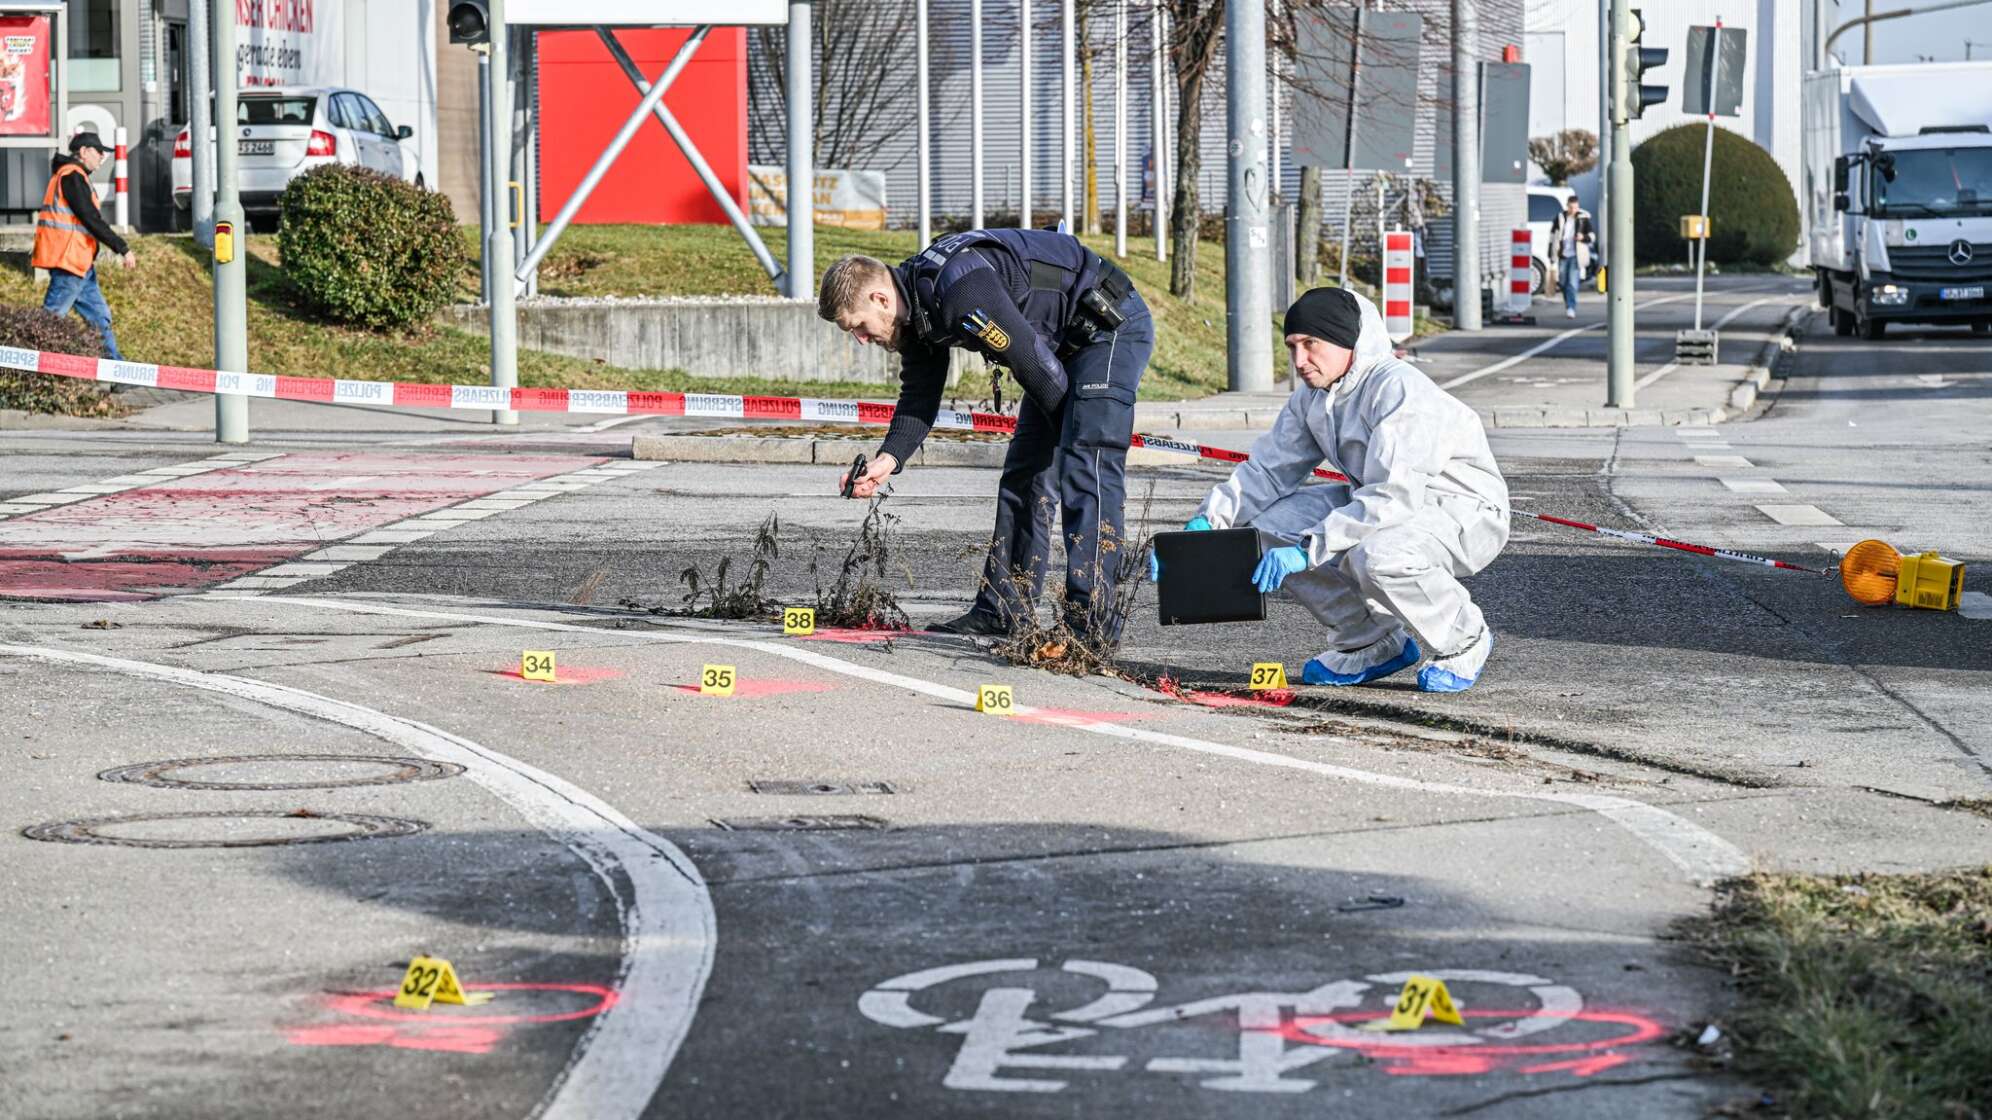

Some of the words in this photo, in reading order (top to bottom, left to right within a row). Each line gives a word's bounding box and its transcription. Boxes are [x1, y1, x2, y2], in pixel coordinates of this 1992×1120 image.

[236, 0, 264, 28] NSER
[268, 0, 313, 33] CHICKEN
[237, 38, 276, 72] gerade
[278, 40, 301, 70] eben
[786, 612, 811, 629] 38
[525, 656, 552, 673] 34
[704, 669, 732, 688] 35
[1253, 667, 1278, 685] 37
[984, 690, 1011, 709] 36
[404, 966, 439, 997] 32
[1398, 983, 1431, 1018] 31
